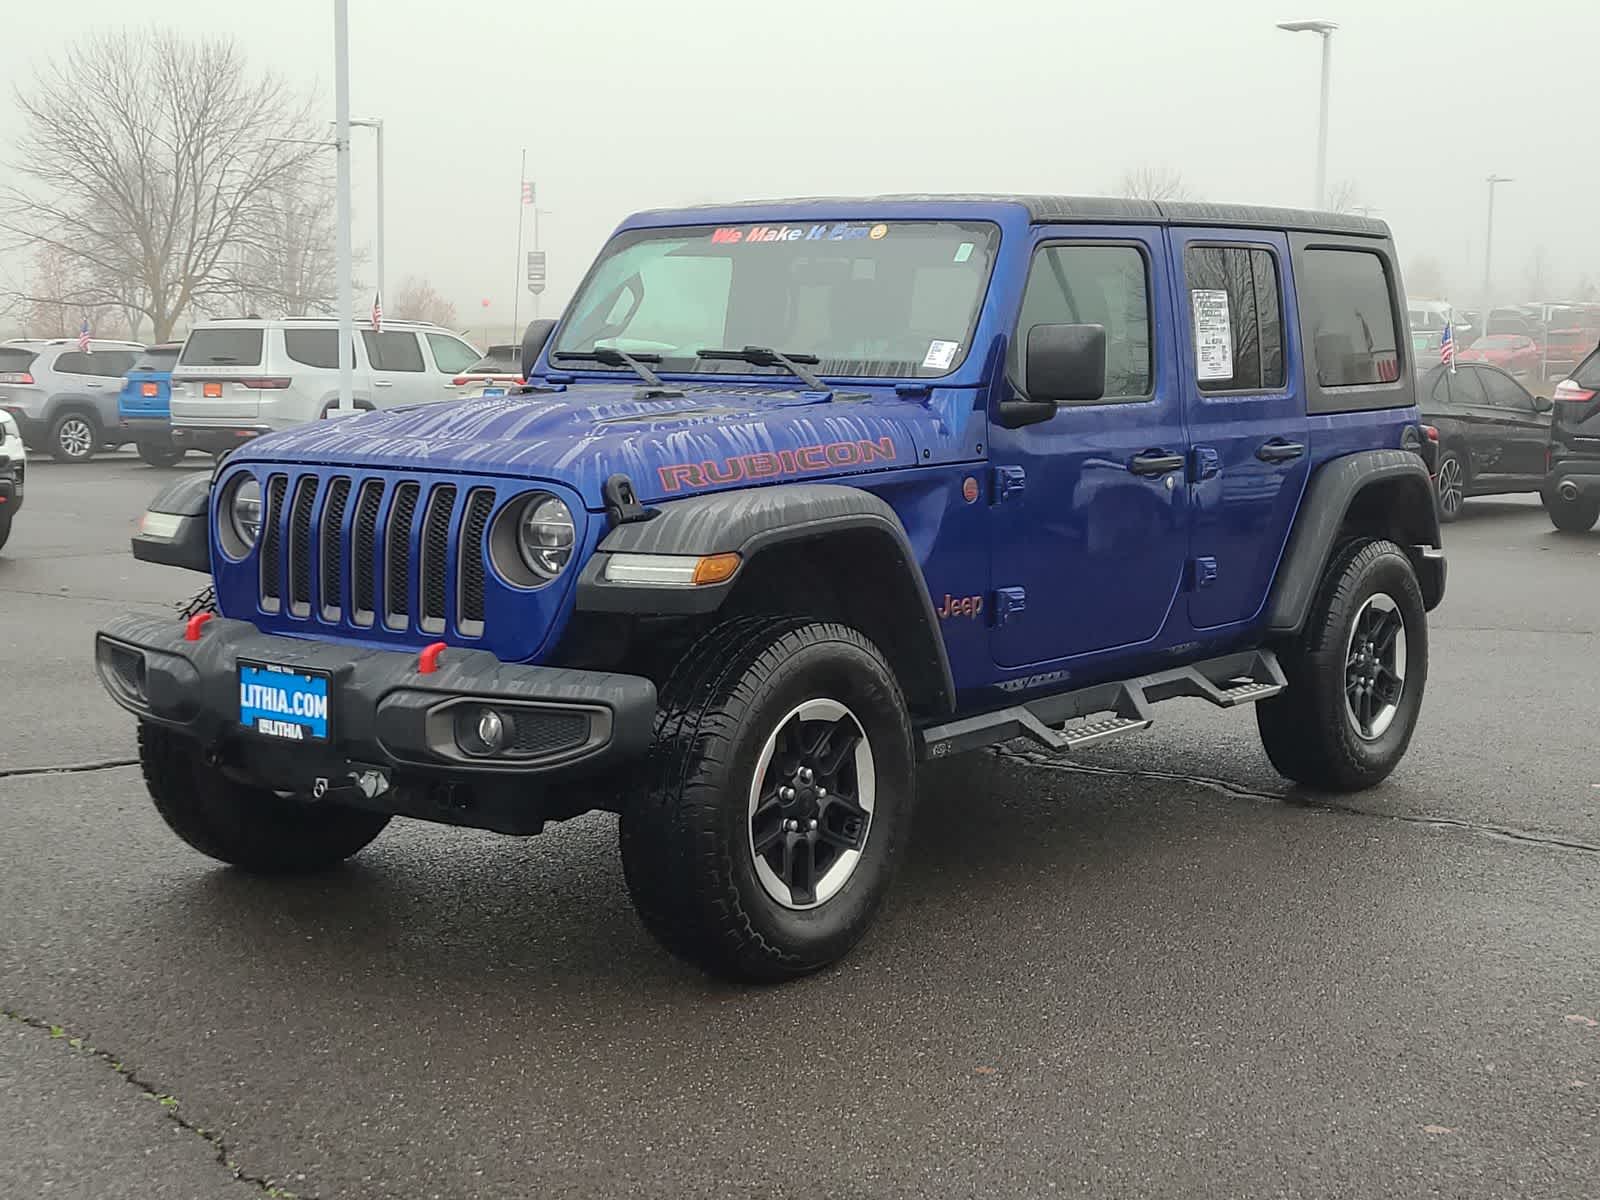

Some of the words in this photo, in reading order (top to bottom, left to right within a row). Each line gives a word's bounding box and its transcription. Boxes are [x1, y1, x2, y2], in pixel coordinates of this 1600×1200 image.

[711, 228, 742, 244] We
[746, 226, 803, 242] Make
[806, 225, 828, 240] It
[657, 436, 897, 492] RUBICON
[938, 594, 984, 620] Jeep
[240, 682, 328, 720] LITHIA.COM
[271, 721, 304, 740] LITHIA
